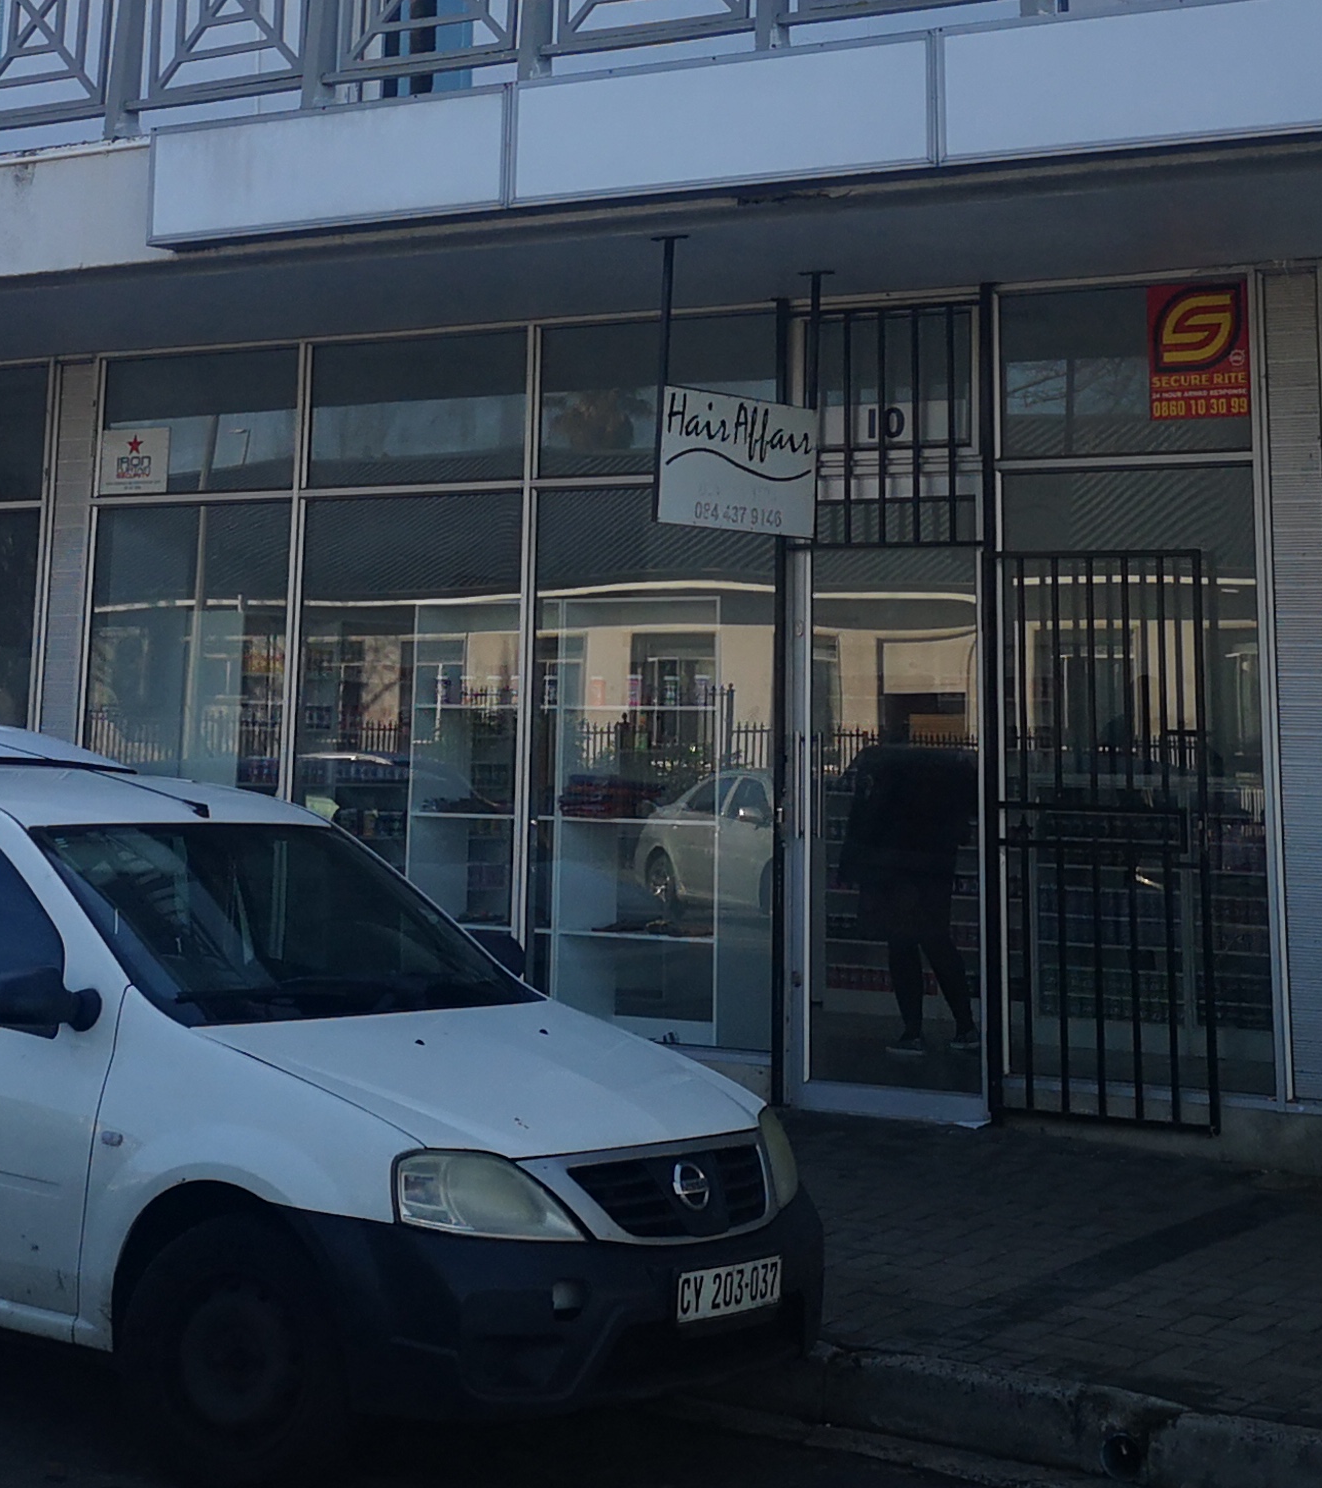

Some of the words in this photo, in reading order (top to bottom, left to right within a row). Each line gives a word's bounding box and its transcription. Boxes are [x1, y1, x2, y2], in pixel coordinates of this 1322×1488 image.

[1151, 373, 1210, 388] SECURE
[1213, 372, 1247, 385] RITE
[1152, 400, 1186, 418] 0860
[1190, 398, 1207, 416] 10
[1210, 397, 1227, 415] 30
[1231, 396, 1248, 414] 99
[680, 1275, 705, 1315] CY
